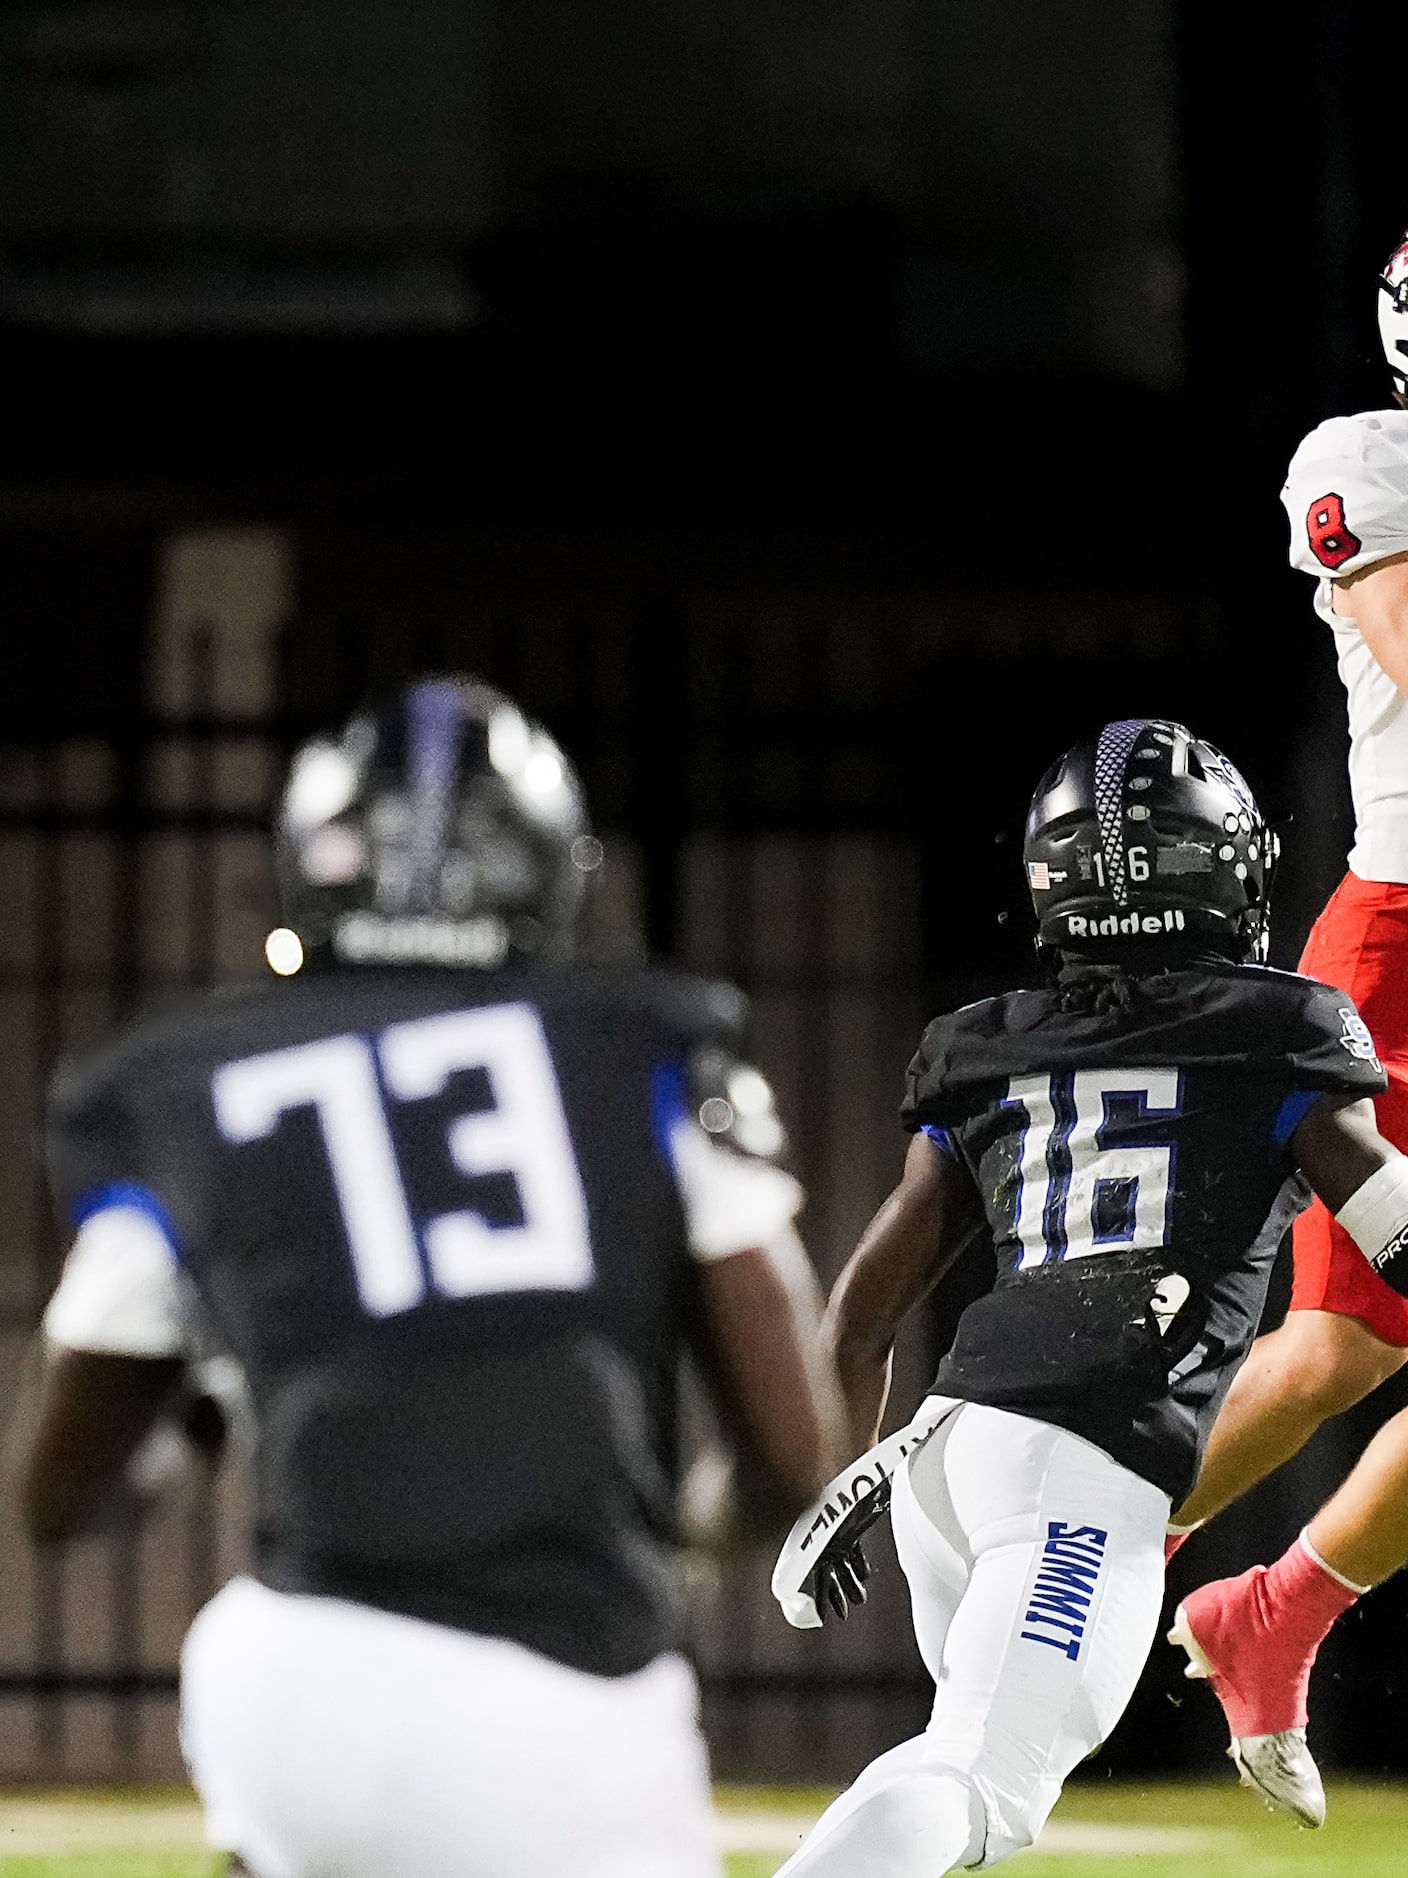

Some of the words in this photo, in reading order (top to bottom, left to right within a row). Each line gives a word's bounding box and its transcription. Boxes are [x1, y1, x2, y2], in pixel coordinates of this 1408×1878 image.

[1306, 492, 1362, 569] 8
[1067, 909, 1186, 938] Riddell
[212, 1002, 595, 1318] 73
[1001, 1068, 1185, 1271] 16
[1020, 1521, 1108, 1662] SUMMIT
